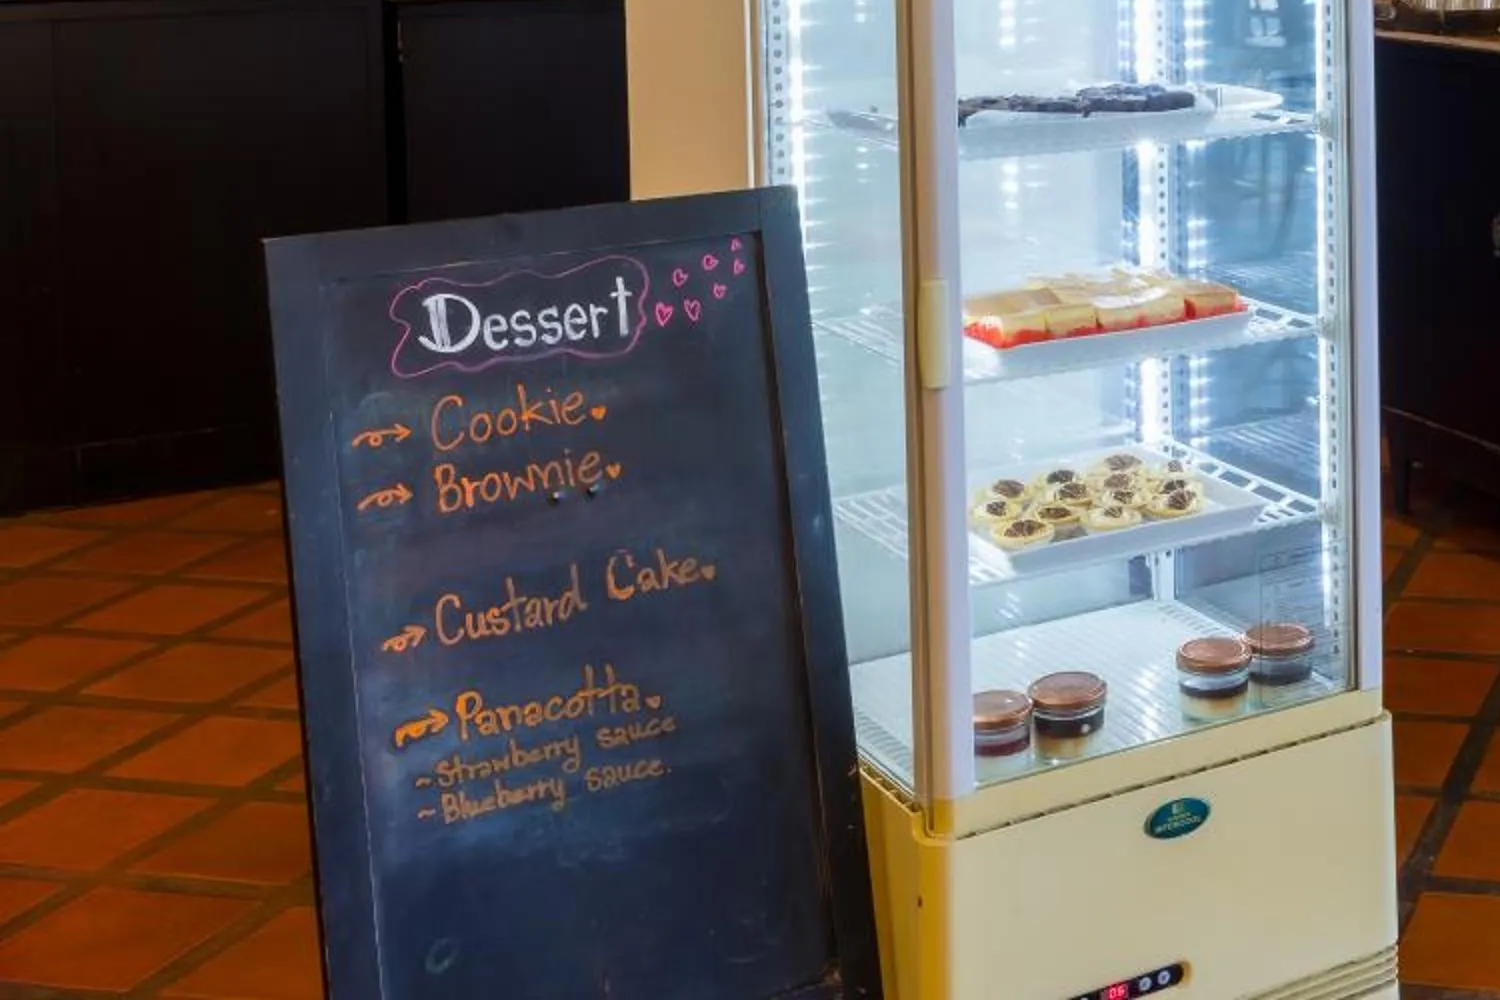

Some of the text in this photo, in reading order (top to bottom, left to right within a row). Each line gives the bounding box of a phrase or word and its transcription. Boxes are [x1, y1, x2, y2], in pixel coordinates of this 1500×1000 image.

[418, 276, 633, 353] Dessert
[431, 383, 587, 450] Cookie
[433, 448, 603, 513] Brownie
[435, 548, 701, 646] Custard Cake
[455, 664, 641, 741] Panacotta
[435, 734, 582, 787] Strawberry
[442, 776, 566, 824] Blueberry
